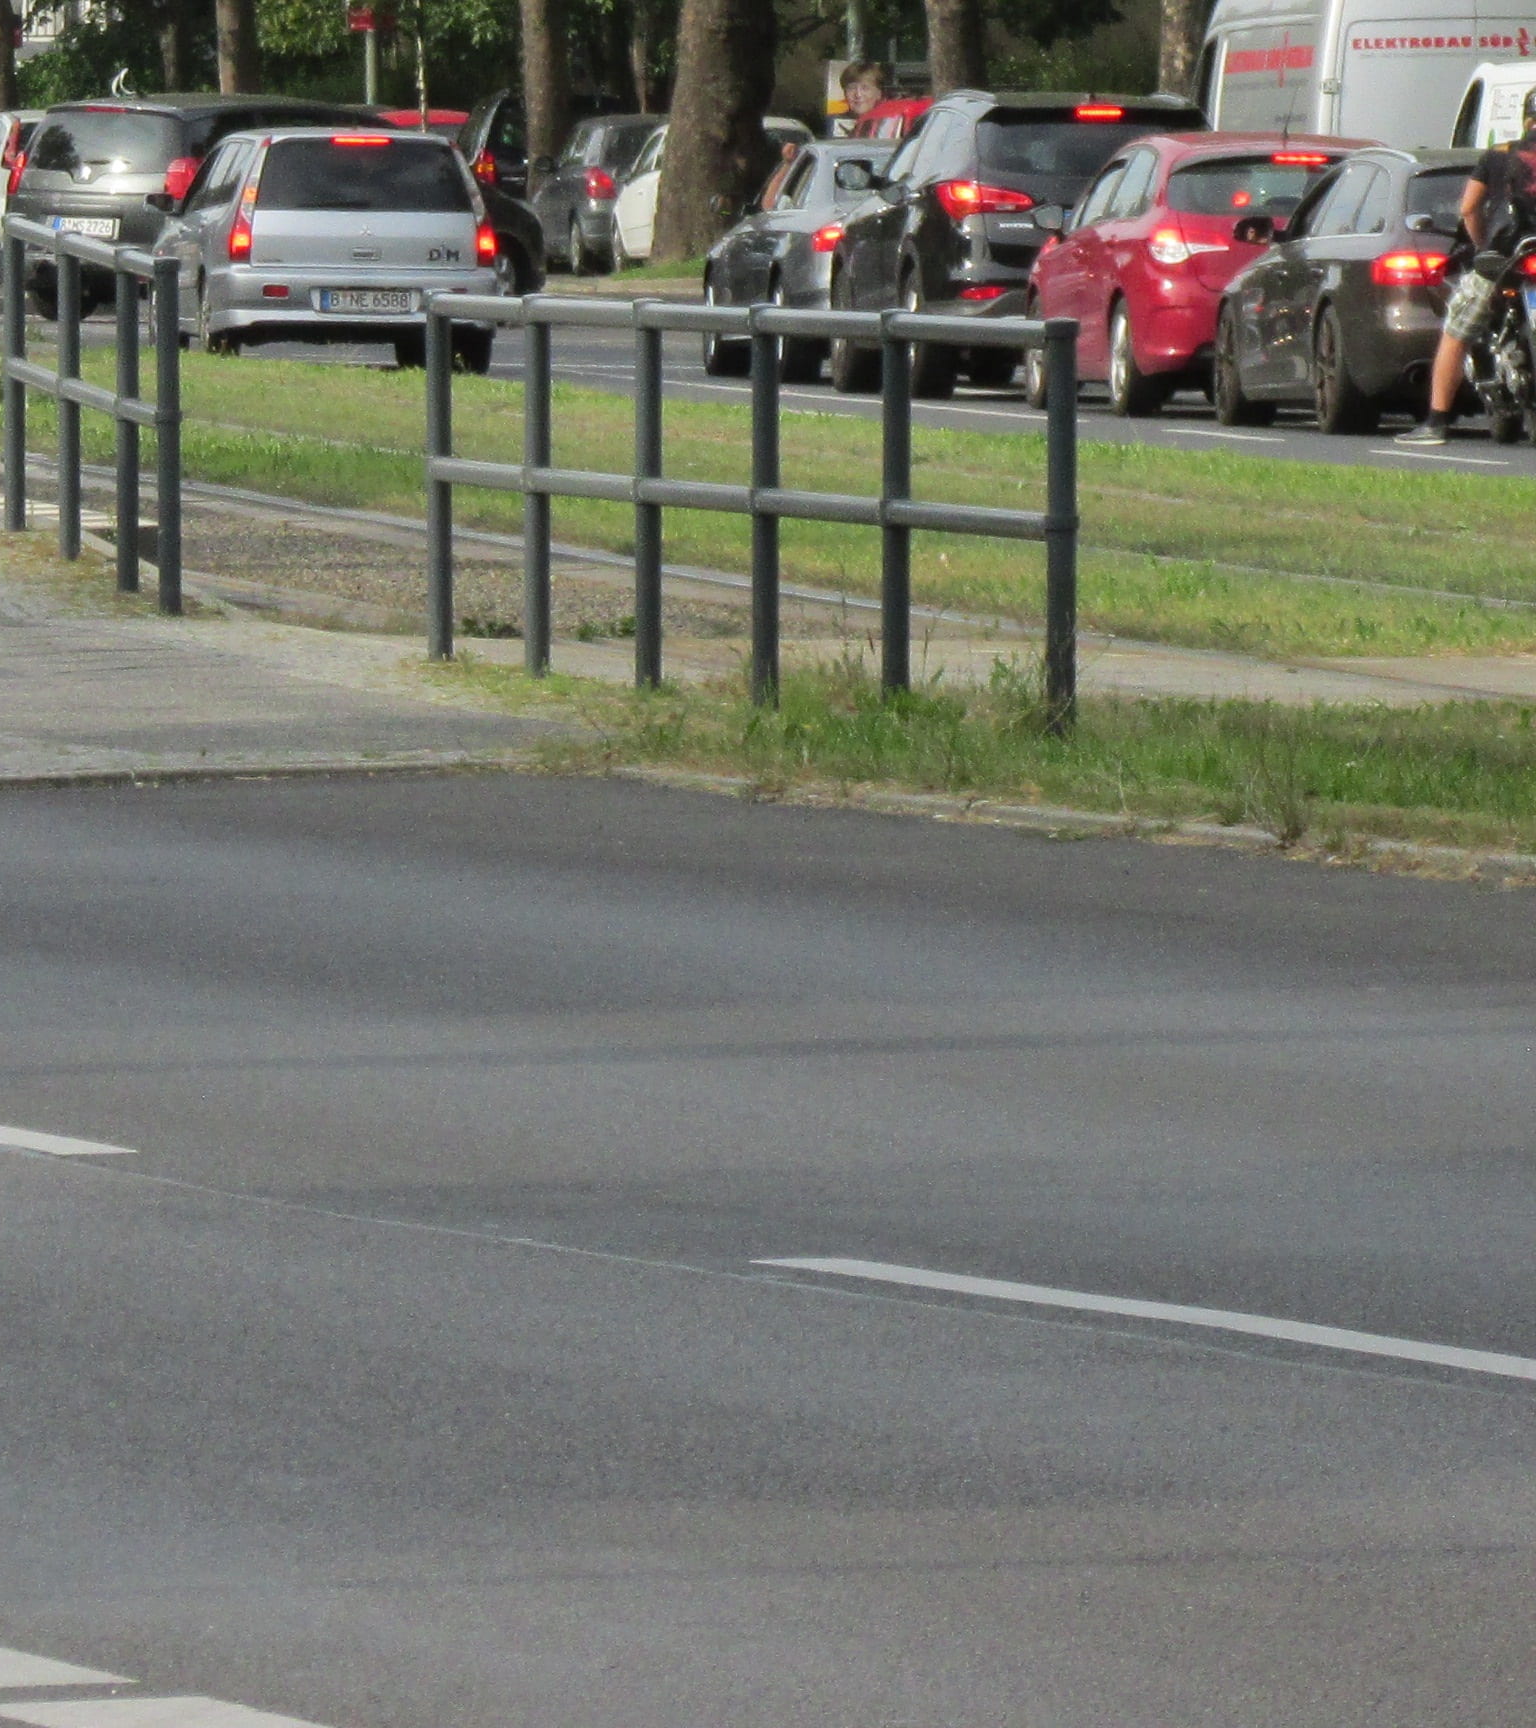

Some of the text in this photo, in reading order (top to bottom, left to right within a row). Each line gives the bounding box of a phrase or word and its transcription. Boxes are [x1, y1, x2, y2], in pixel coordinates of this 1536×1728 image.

[1352, 33, 1514, 50] ELEKTROBAU SÜD
[86, 220, 112, 233] 2726
[349, 293, 369, 308] NE
[372, 292, 409, 308] 6588
